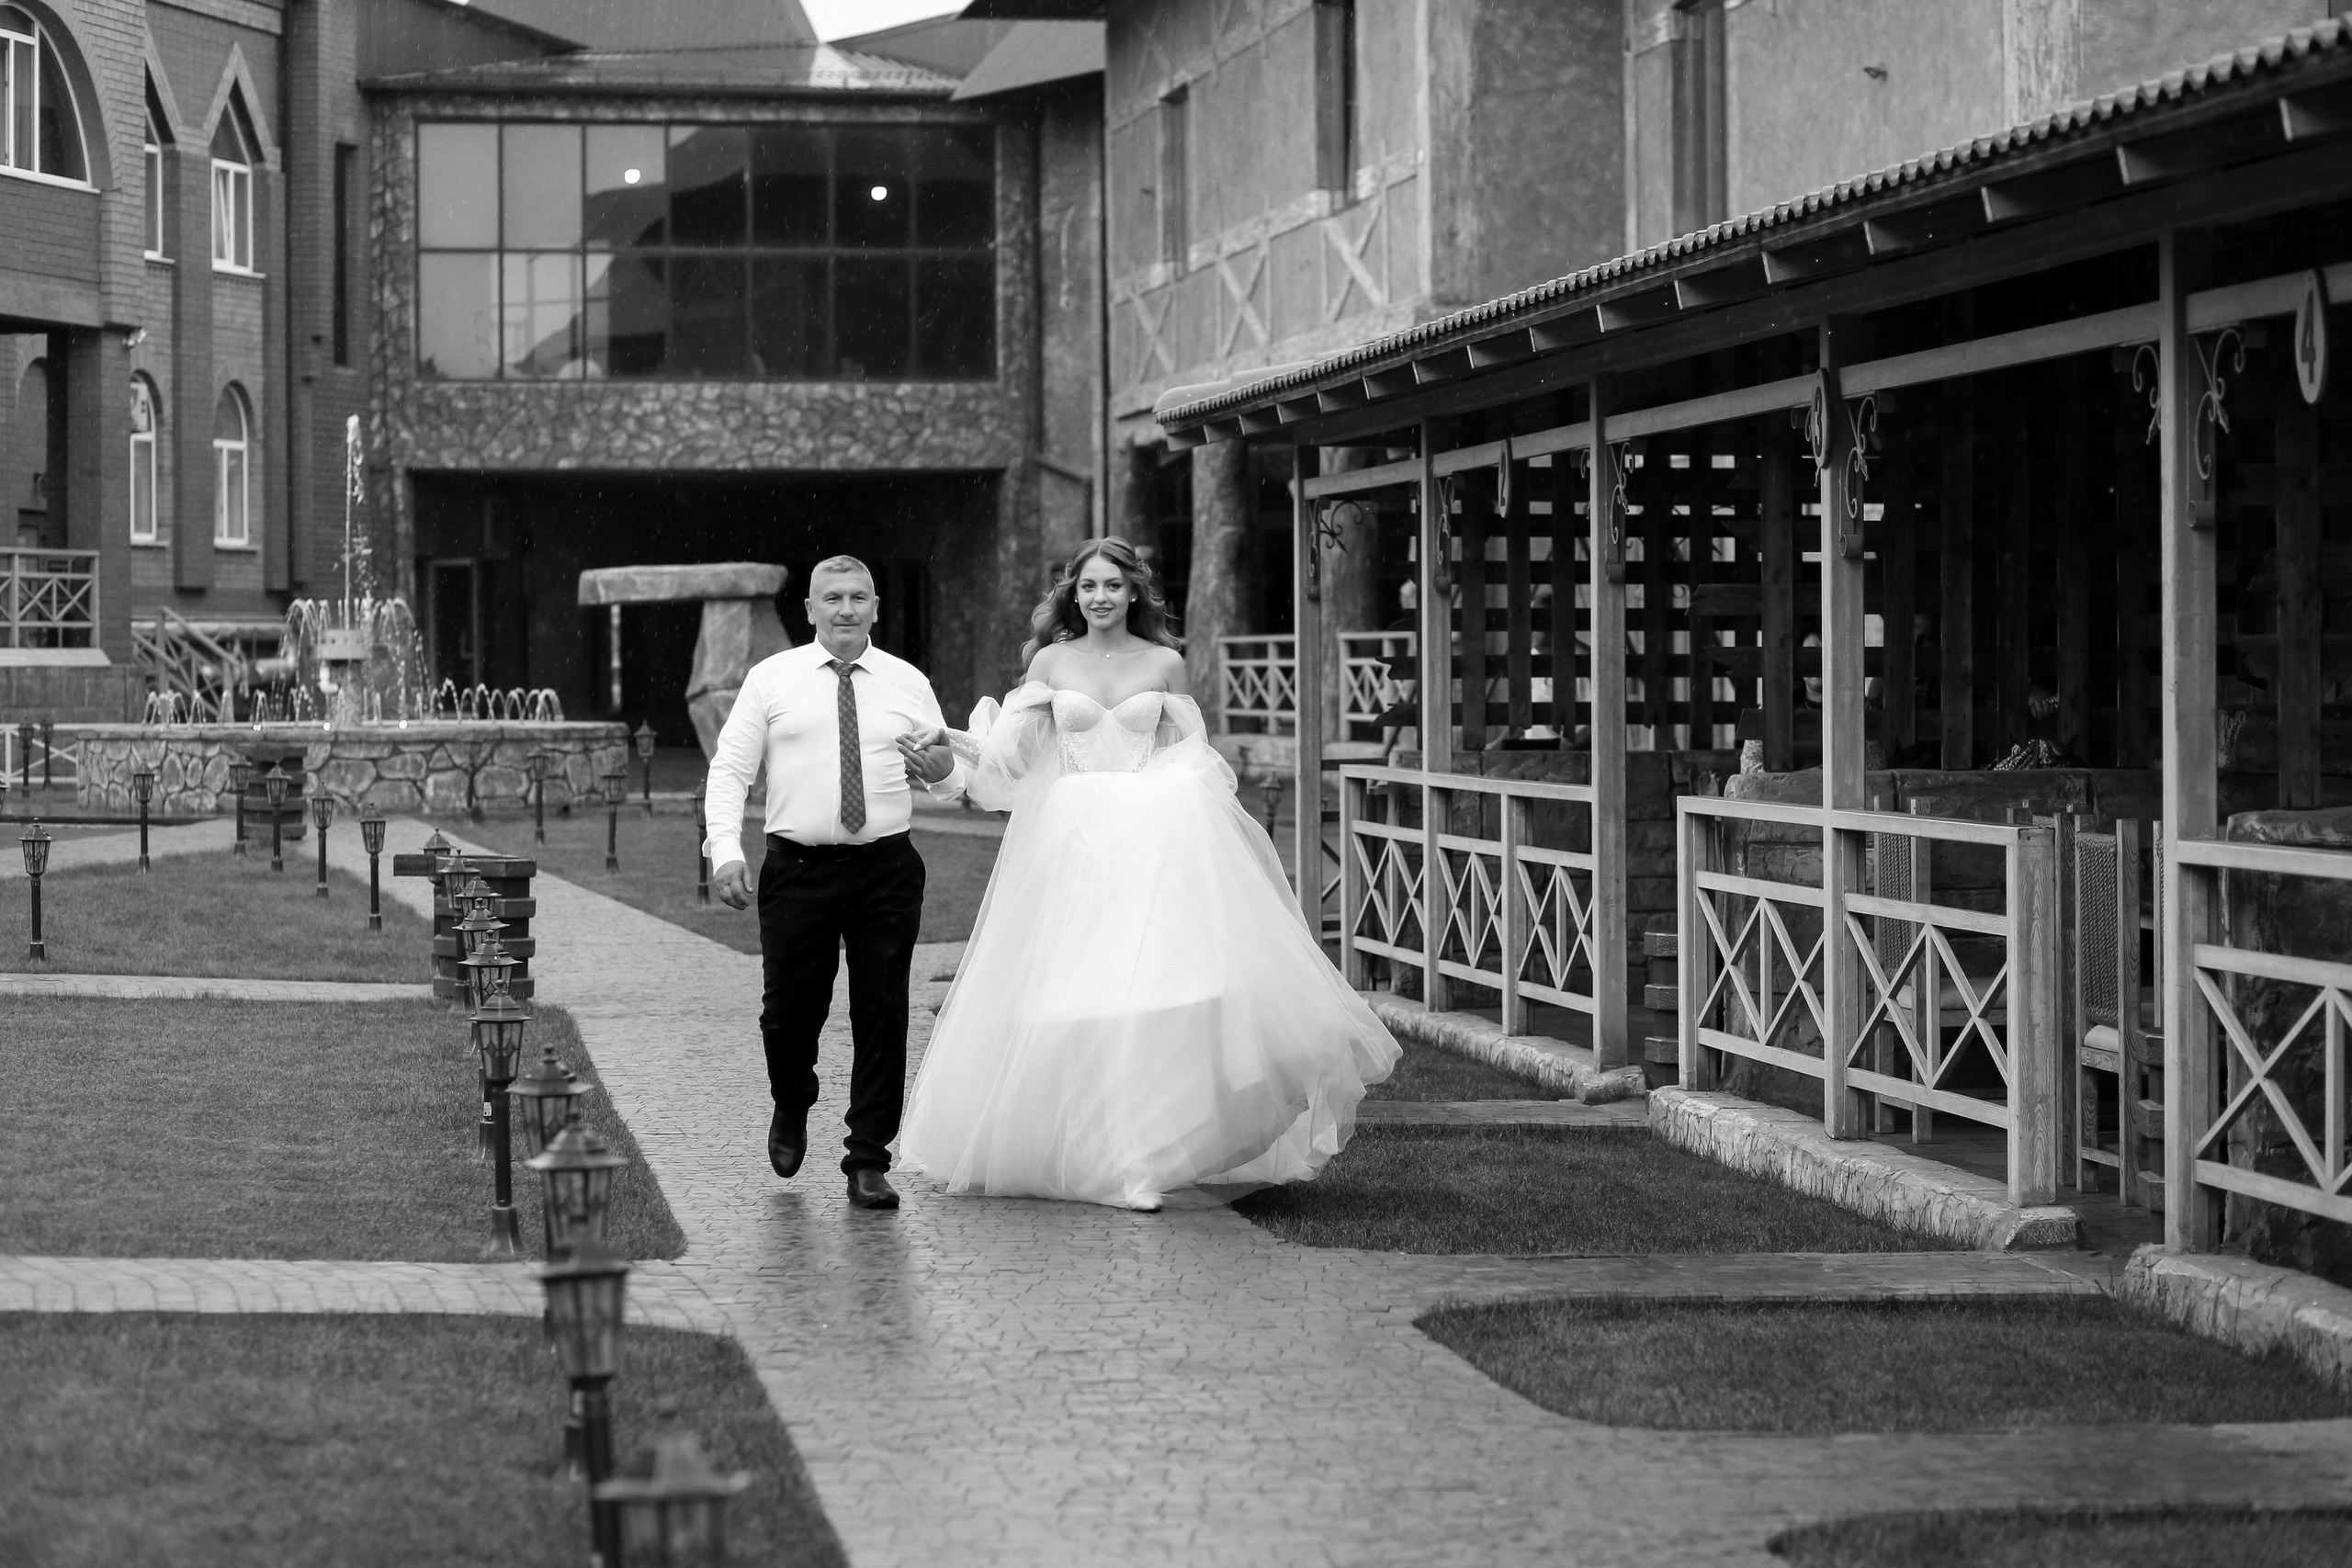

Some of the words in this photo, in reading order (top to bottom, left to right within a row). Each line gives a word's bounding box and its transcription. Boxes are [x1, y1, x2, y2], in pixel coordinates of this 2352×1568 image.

[2301, 289, 2316, 384] 4
[1815, 386, 1823, 457] 3
[1500, 451, 1507, 507] 2
